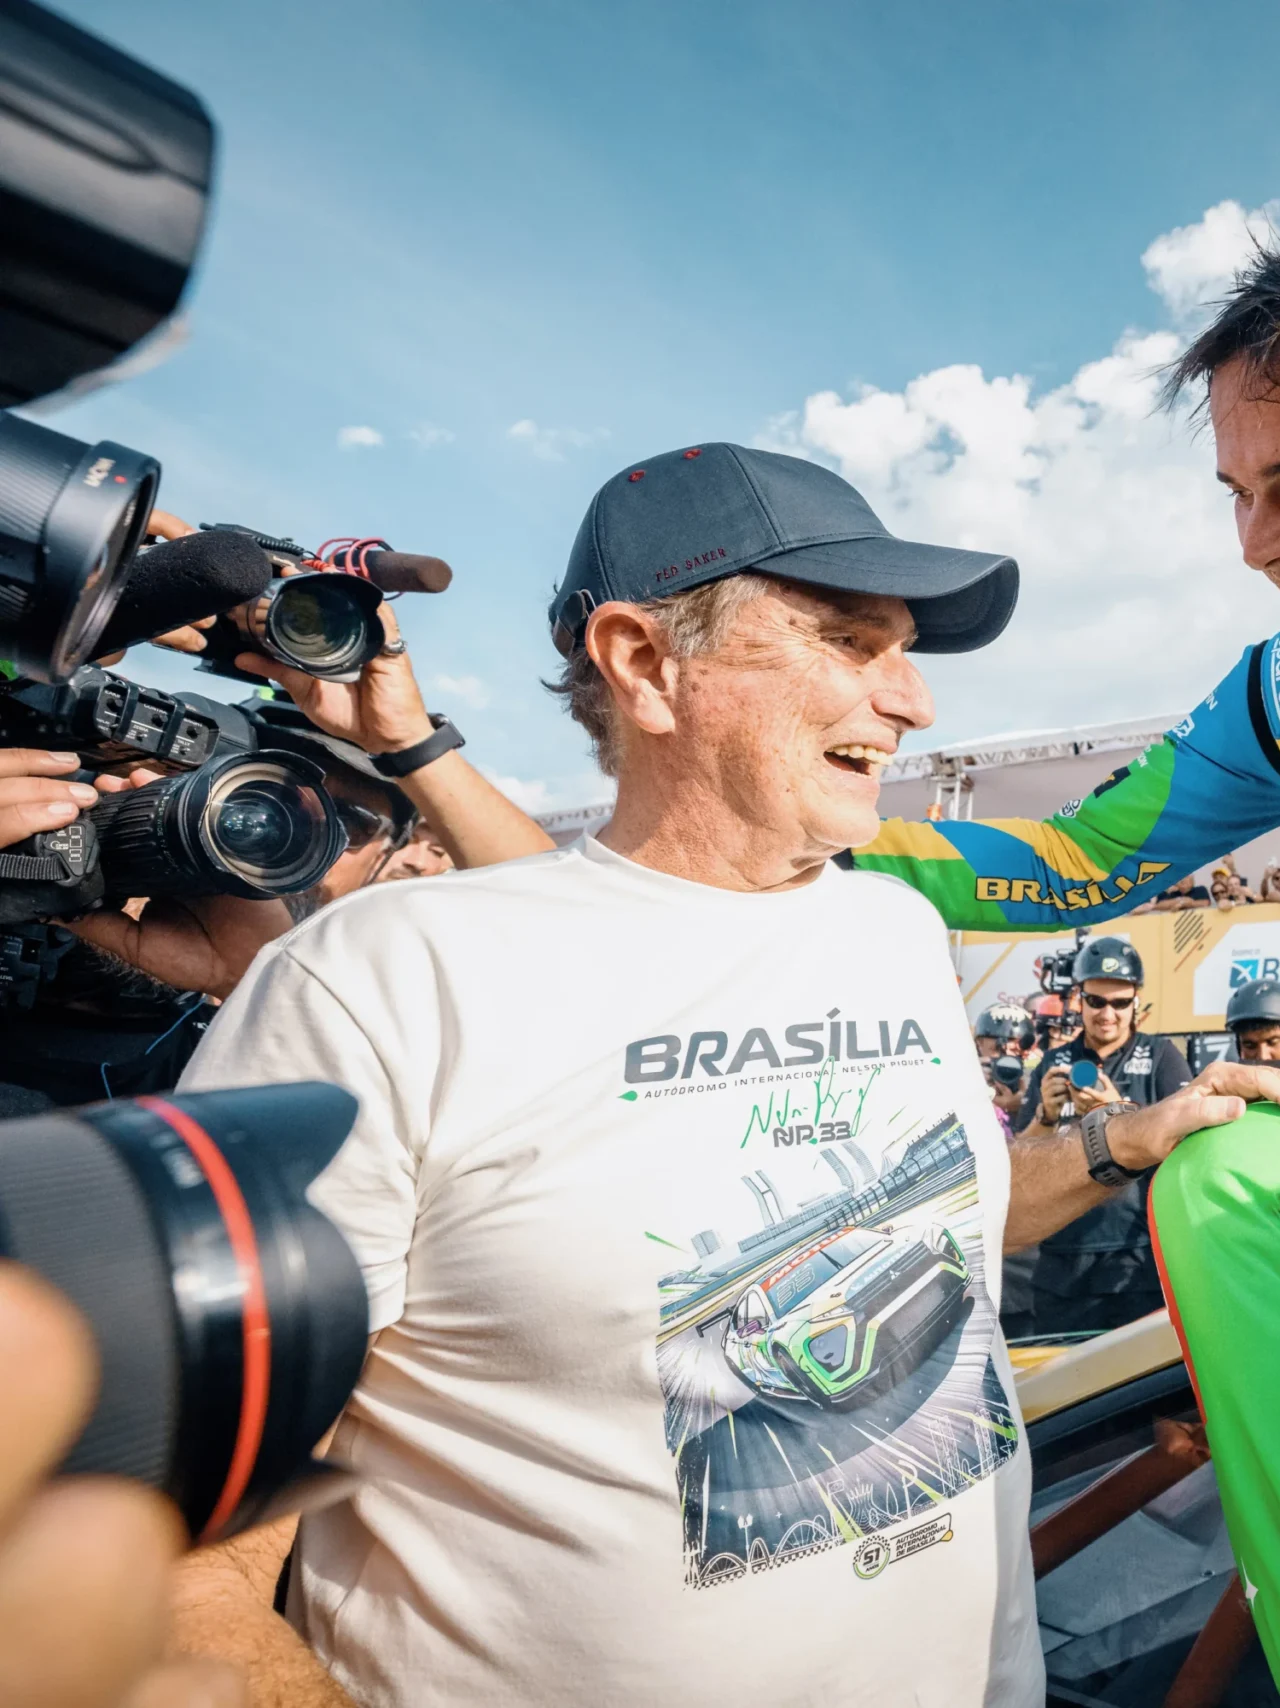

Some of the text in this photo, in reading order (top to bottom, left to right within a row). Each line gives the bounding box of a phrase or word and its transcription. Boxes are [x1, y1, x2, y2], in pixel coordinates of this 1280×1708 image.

[656, 565, 679, 583] TED
[623, 1007, 933, 1085] BRASÍLIA
[644, 1081, 727, 1100] AUTÓDROMO
[842, 1061, 887, 1075] NELSON
[890, 1058, 925, 1069] PIQUET
[863, 1547, 881, 1567] 51
[896, 1547, 906, 1558] DE
